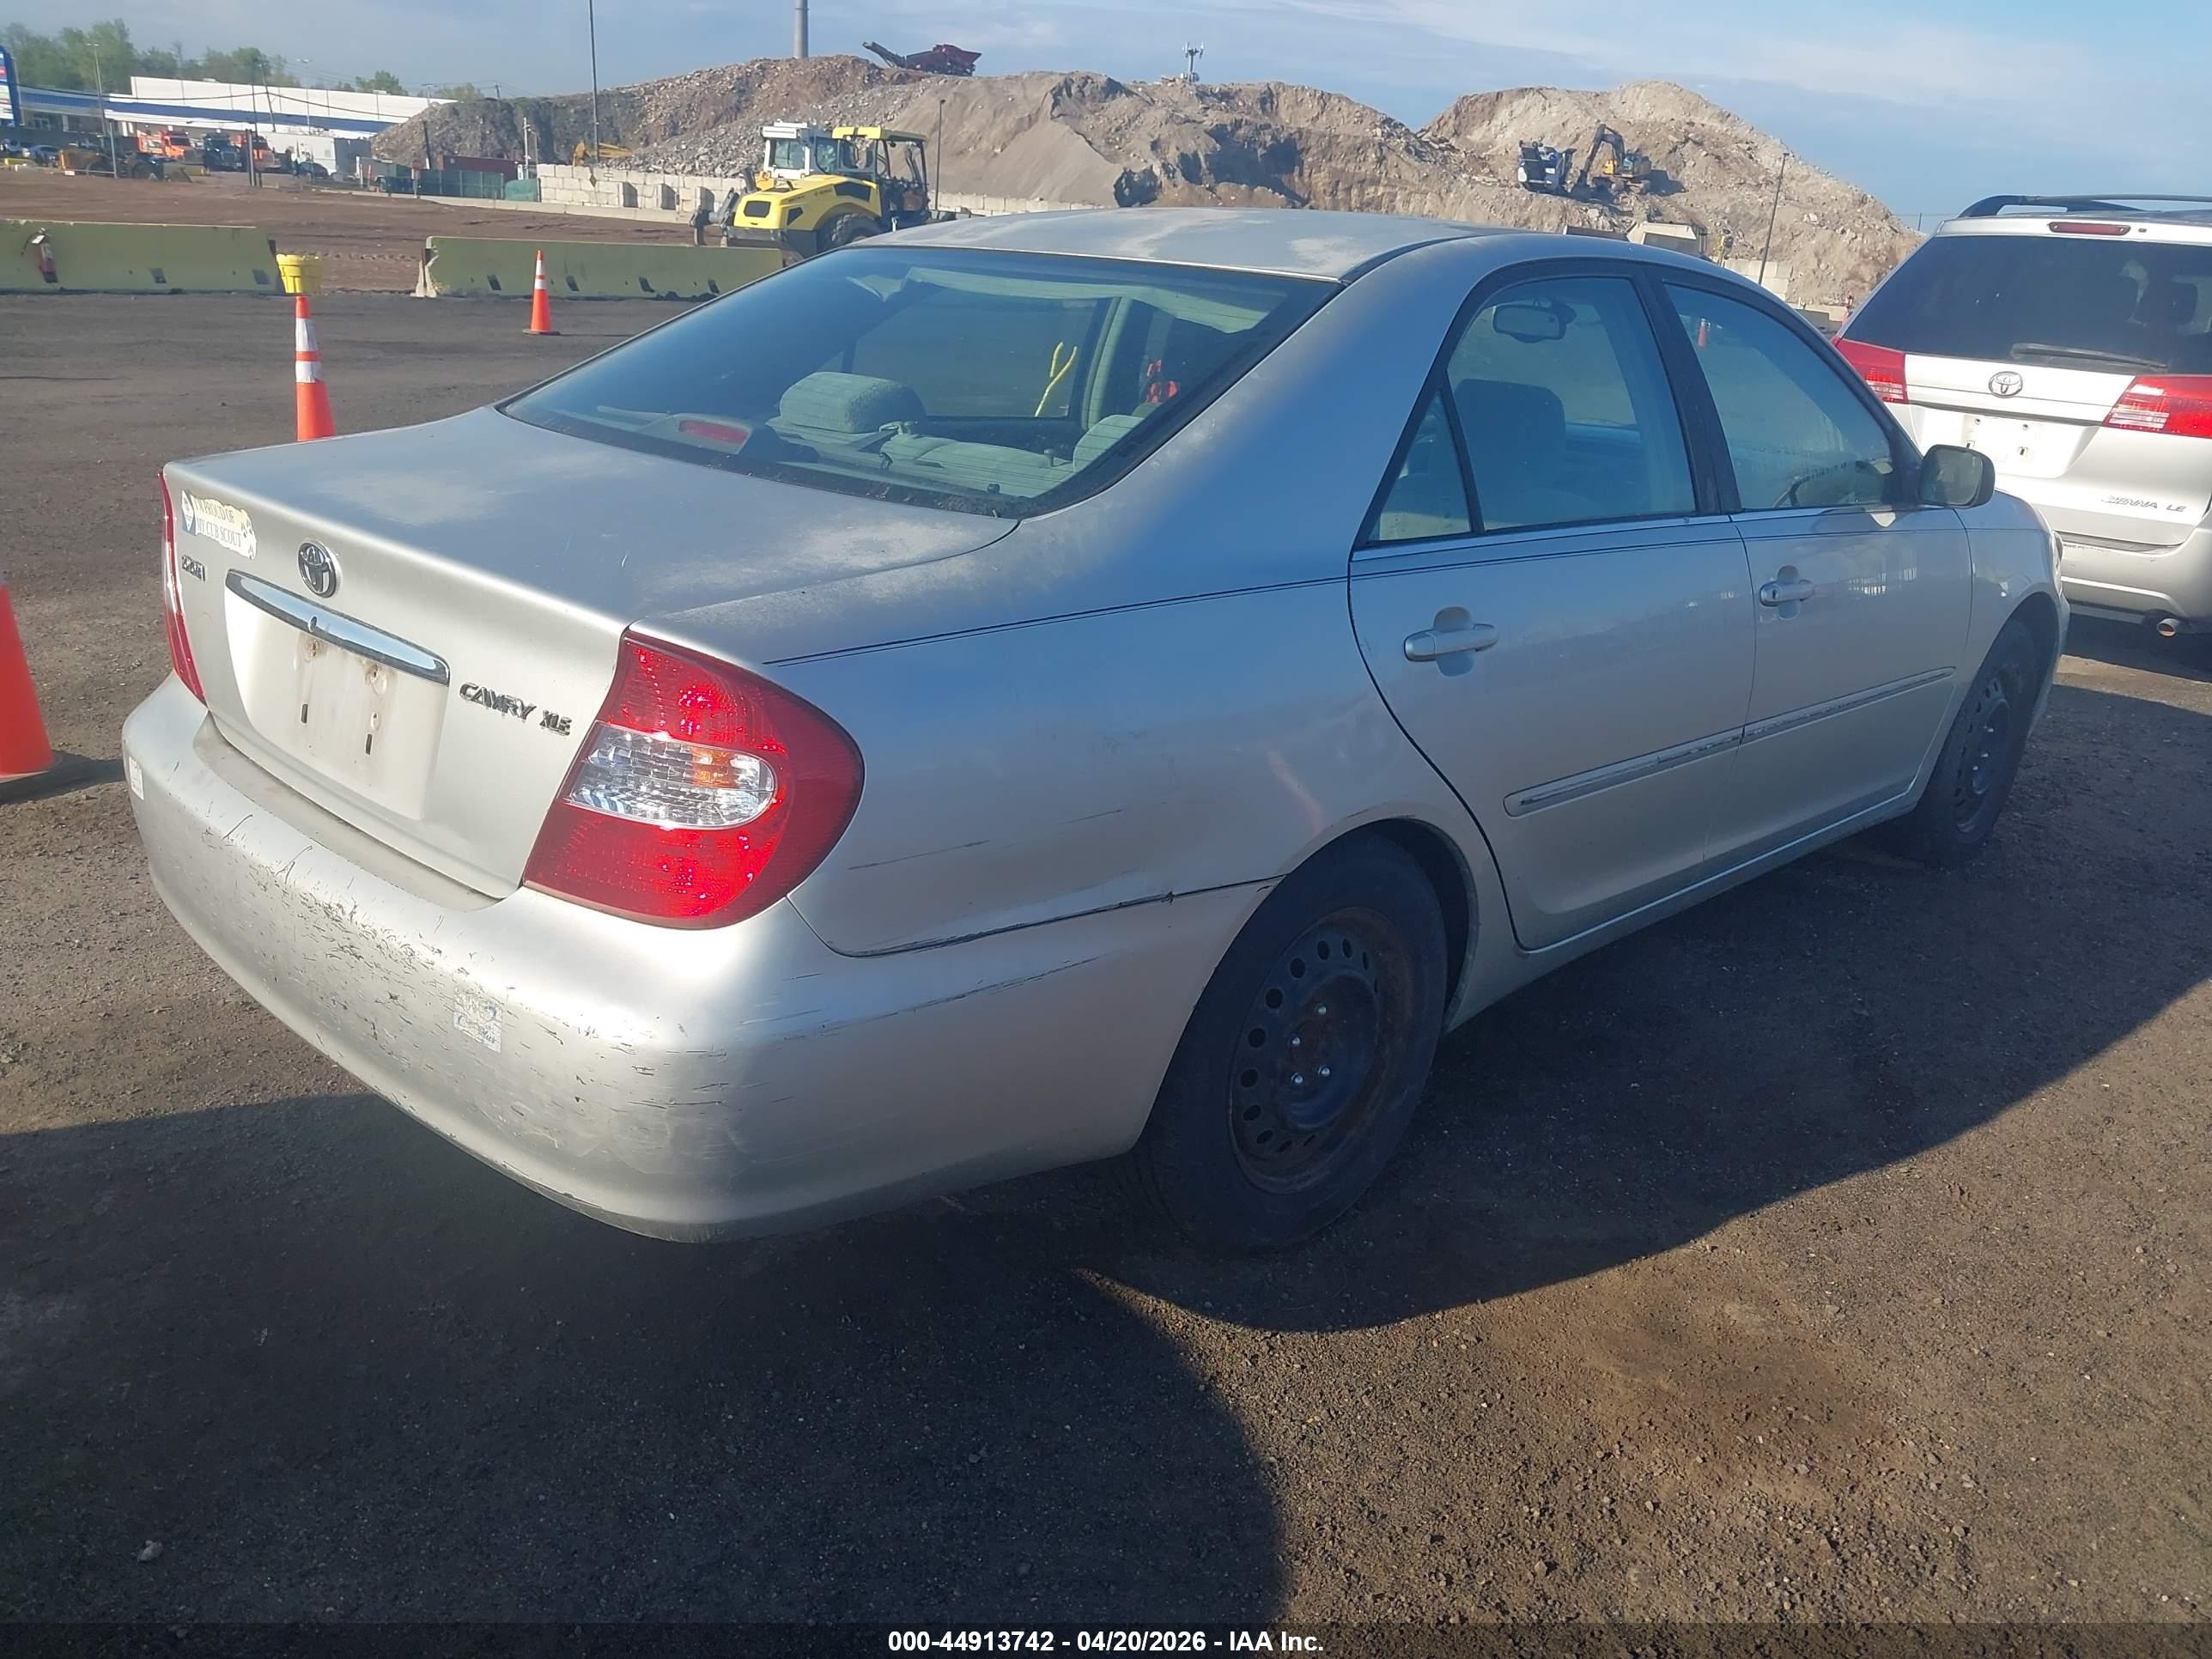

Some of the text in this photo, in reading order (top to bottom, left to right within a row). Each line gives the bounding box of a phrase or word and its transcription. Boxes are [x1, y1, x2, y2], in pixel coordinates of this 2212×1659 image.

[2166, 503, 2187, 513] LE
[197, 517, 241, 547] MY CUB SCOUT
[459, 682, 573, 737] CAMRY XLE
